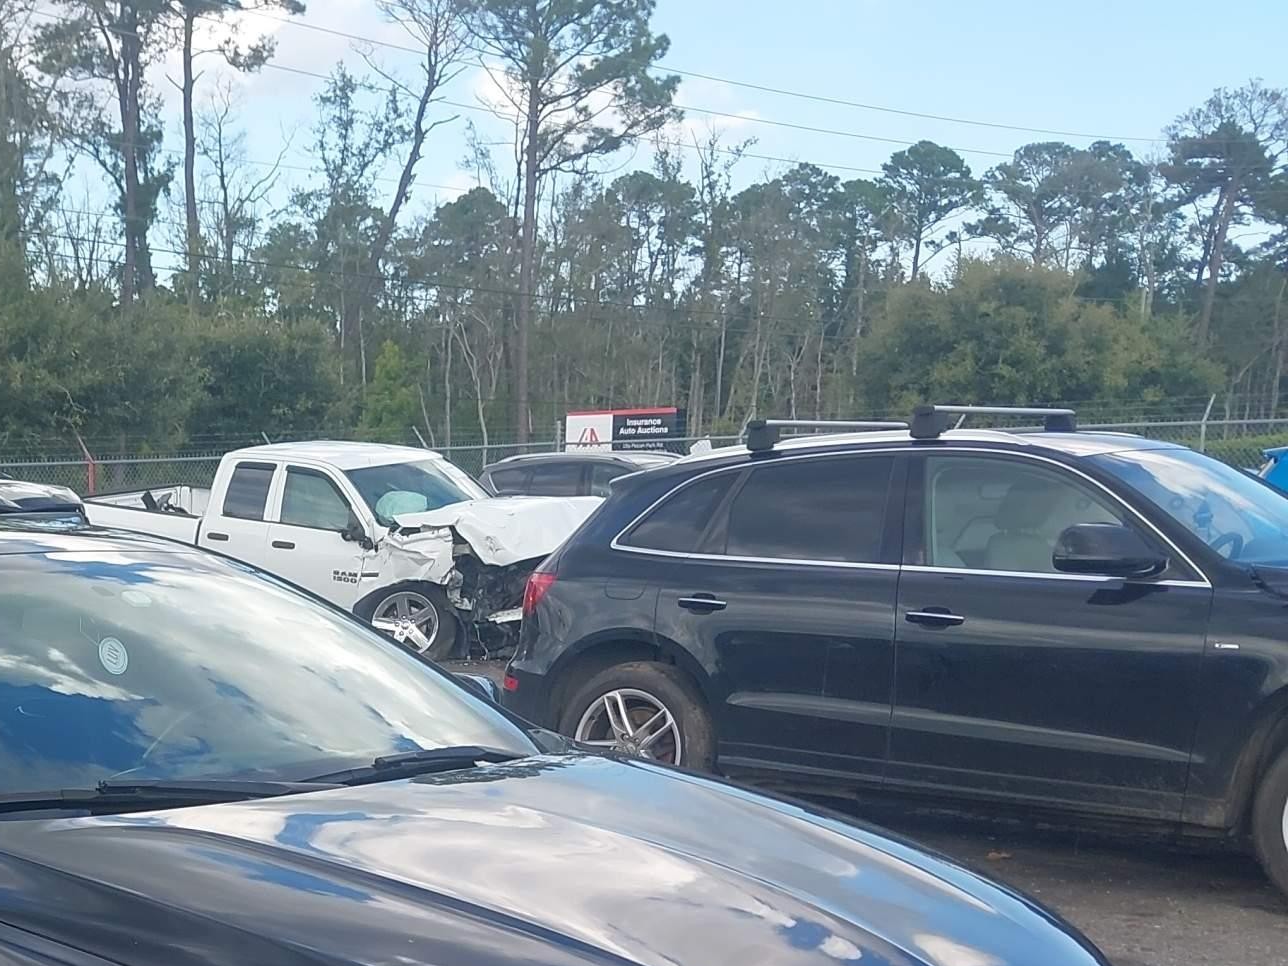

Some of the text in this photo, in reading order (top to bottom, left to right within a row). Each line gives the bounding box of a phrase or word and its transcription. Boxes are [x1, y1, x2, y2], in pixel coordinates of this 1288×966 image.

[626, 418, 661, 426] Insurance
[618, 426, 668, 435] Auto Auctions
[333, 570, 358, 578] RAM
[333, 575, 358, 584] 1500
